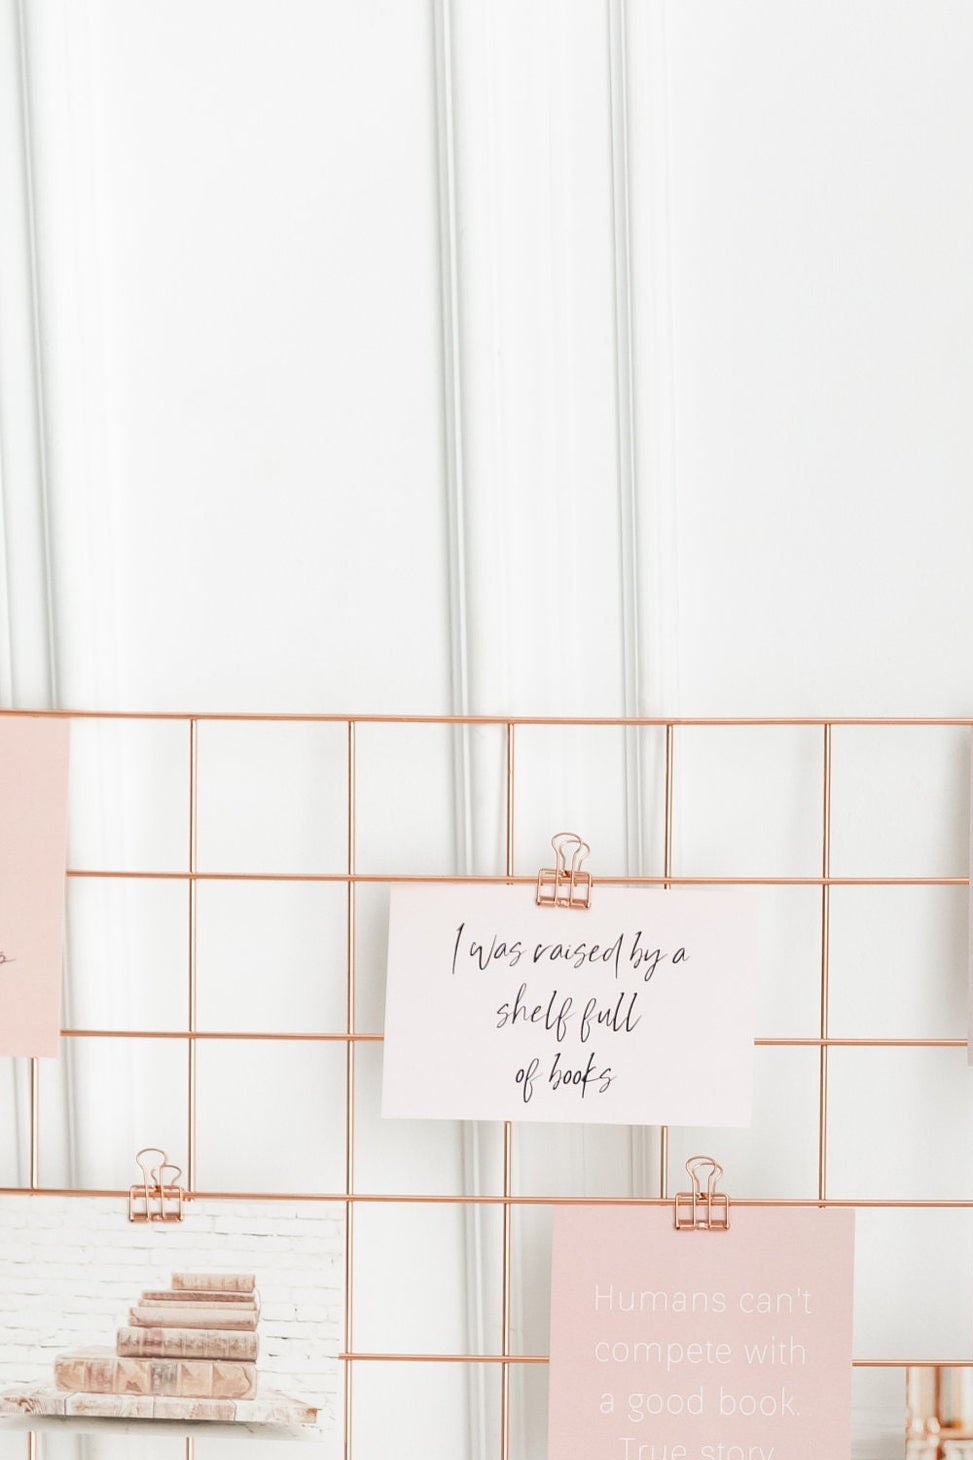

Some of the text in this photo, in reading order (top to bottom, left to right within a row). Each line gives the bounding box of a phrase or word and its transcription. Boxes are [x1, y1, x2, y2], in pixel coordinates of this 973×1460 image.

[452, 923, 690, 981] I was raised by a
[496, 982, 642, 1042] shelf full
[515, 1052, 618, 1103] of books
[595, 1284, 812, 1314] Humans can't
[595, 1335, 807, 1372] compete with
[600, 1385, 800, 1423] a good book.
